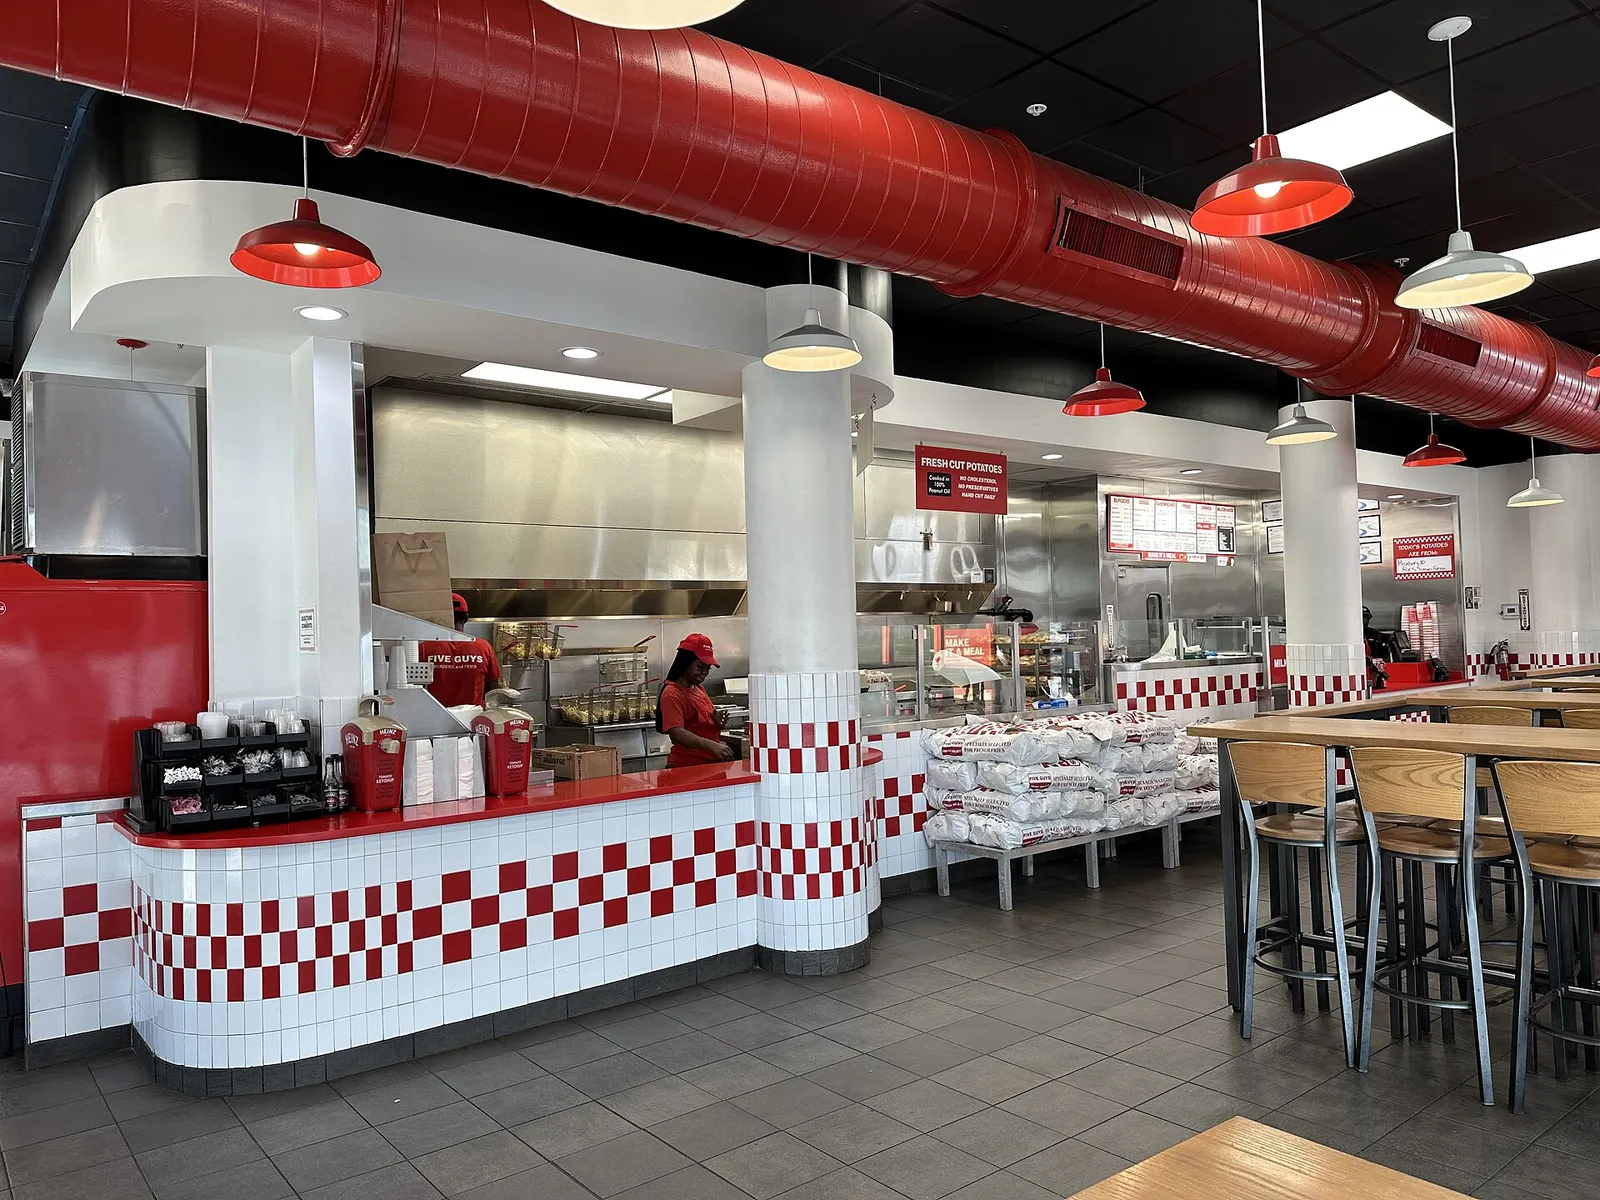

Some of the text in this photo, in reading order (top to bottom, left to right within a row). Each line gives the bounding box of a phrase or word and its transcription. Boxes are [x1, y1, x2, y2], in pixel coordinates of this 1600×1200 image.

[922, 457, 1003, 474] FRESH CUT POTATOES
[945, 639, 969, 647] MAKE
[964, 647, 984, 656] MEAL
[454, 655, 483, 663] GUYS
[475, 724, 490, 736] HEINZ
[344, 732, 359, 747] HEINZ
